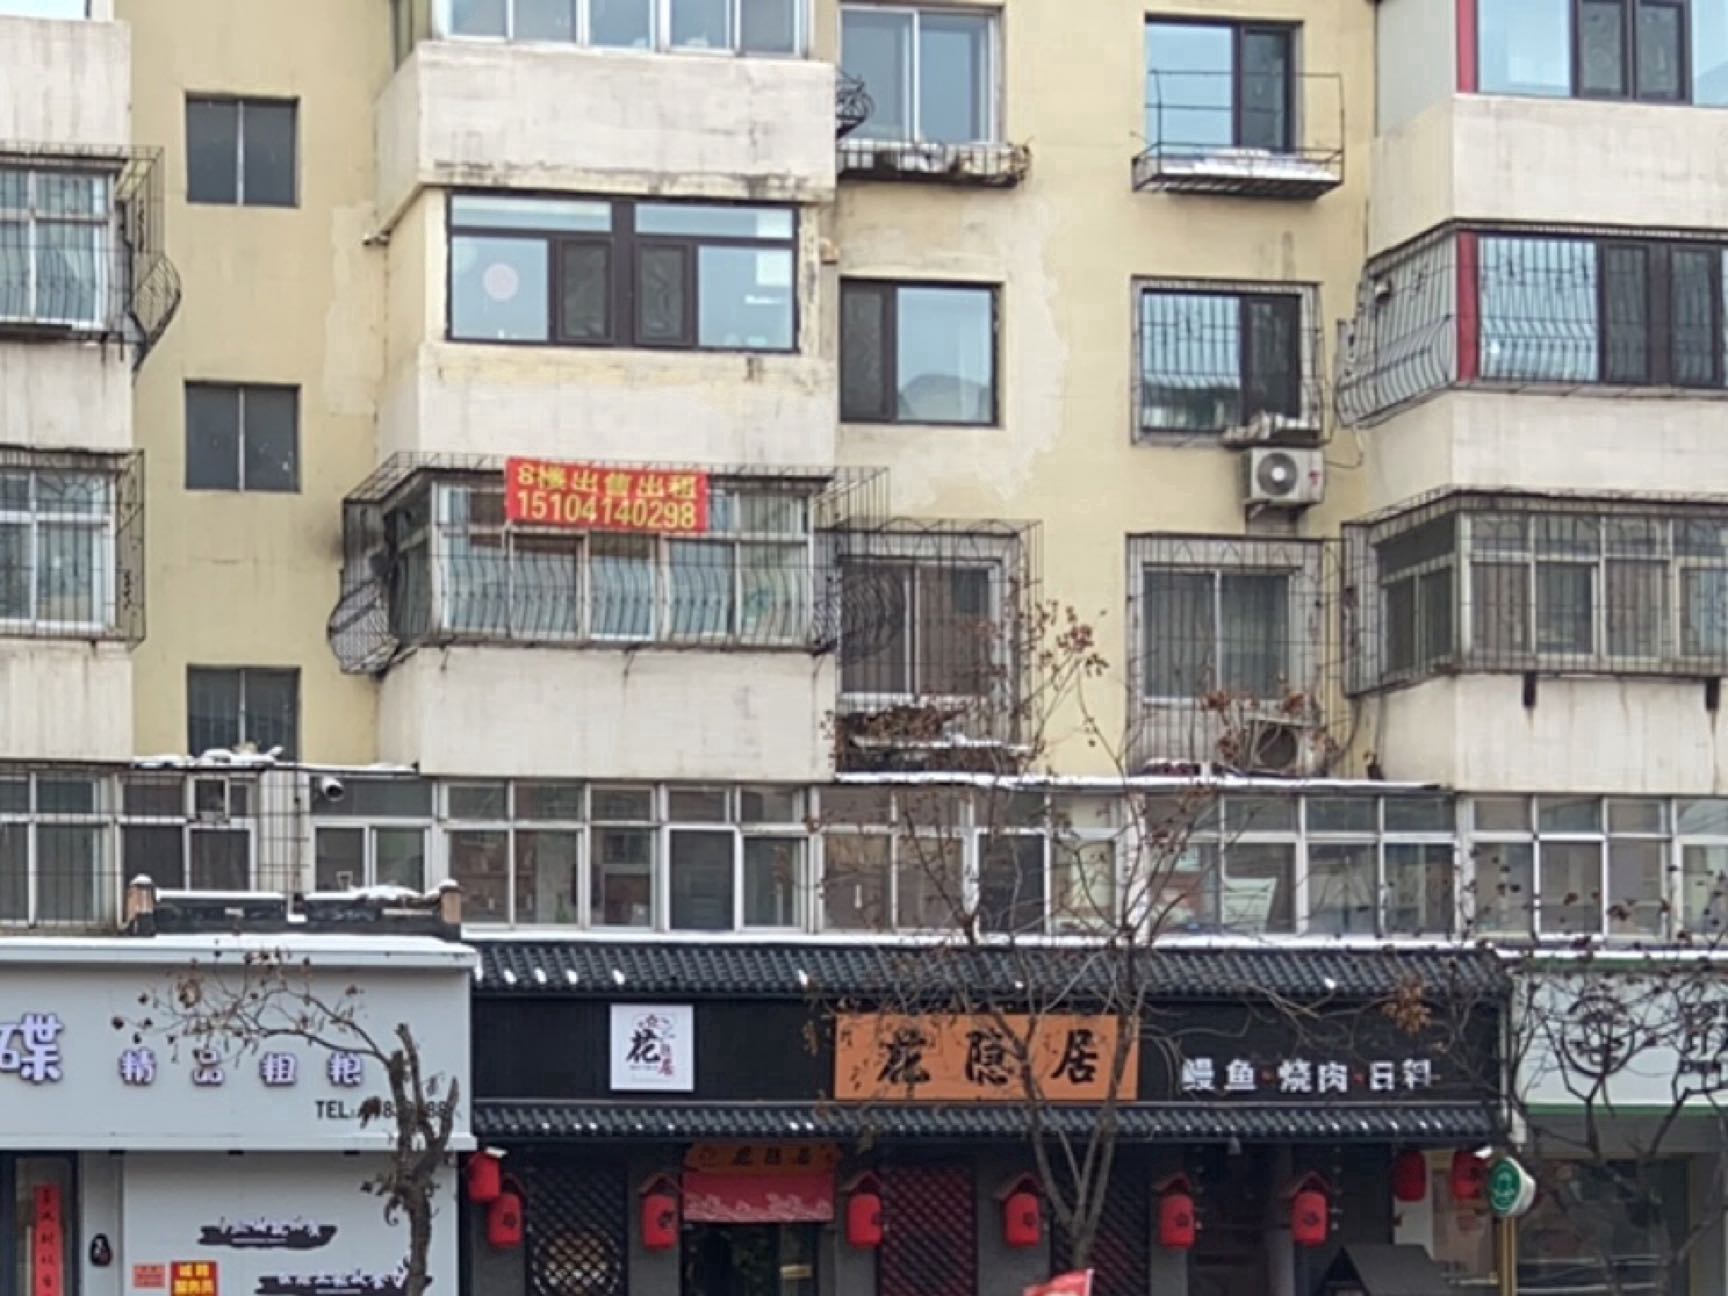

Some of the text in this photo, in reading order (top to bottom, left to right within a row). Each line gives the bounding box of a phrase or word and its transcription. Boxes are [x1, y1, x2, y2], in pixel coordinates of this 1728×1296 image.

[518, 490, 697, 529] 15104140298
[876, 1026, 1100, 1086] 花隐居
